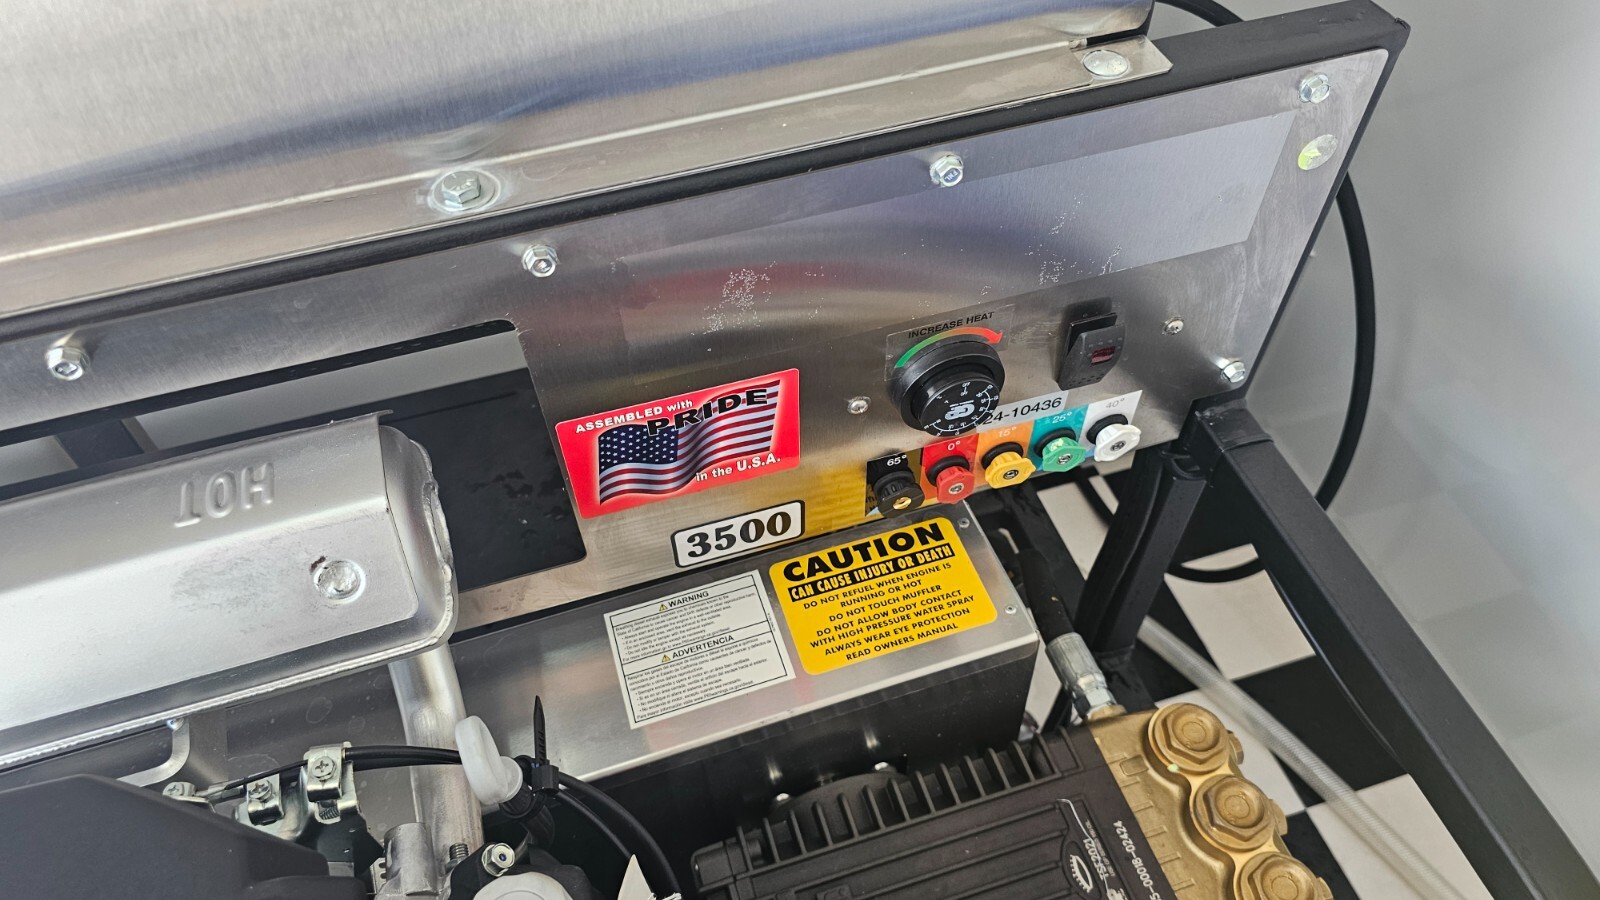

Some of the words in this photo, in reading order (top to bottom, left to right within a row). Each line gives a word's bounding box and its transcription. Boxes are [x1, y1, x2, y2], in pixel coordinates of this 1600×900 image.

[909, 319, 963, 338] INCREASE
[966, 312, 994, 324] HEAT
[575, 405, 663, 433] ASSEMBLED
[666, 400, 693, 412] with
[647, 389, 768, 436] PRIDE
[1052, 412, 1072, 424] 25°
[948, 441, 960, 451] 0°
[998, 426, 1016, 438] 15°
[696, 472, 709, 482] in
[711, 466, 732, 478] the
[736, 452, 781, 471] U.S.A.
[886, 454, 907, 466] 65°
[174, 462, 274, 528] HOT
[687, 511, 791, 557] 3500
[783, 523, 945, 581] CAUTION
[791, 586, 814, 601] CAN
[817, 573, 852, 591] CAUSE
[855, 562, 895, 582] INJURY
[900, 556, 913, 569] OR
[917, 545, 952, 564] DEATH
[804, 601, 817, 609] DO
[820, 595, 840, 604] NOT
[843, 585, 874, 598] REFUEL
[876, 576, 904, 589] WHEN
[907, 566, 941, 580] ENGINE
[668, 590, 709, 607] WARNING
[829, 613, 843, 622] DO
[846, 607, 866, 617] NOT
[868, 597, 900, 610] TOUCH
[902, 585, 942, 600] MUFFLER
[840, 590, 885, 608] RUNNING
[888, 586, 901, 594] OR
[903, 580, 922, 589] HOT
[810, 635, 835, 648] WITH
[840, 627, 864, 639] HIGH
[867, 613, 911, 631] PRESSURE
[914, 604, 945, 617] WATER
[947, 595, 975, 608] SPRAY
[817, 628, 831, 637] DO
[834, 621, 854, 632] NOT
[857, 611, 889, 625] ALLOW
[892, 602, 917, 615] BODY
[920, 590, 962, 606] CONTACT
[825, 640, 861, 655] ALWAYS
[864, 631, 891, 644] WEAR
[894, 625, 909, 634] EYE
[912, 608, 970, 629] PROTECTION
[671, 634, 734, 658] ADVERTENCIA
[846, 647, 871, 660] READ
[874, 635, 915, 651] OWNERS
[917, 623, 958, 639] MANUAL
[1113, 820, 1161, 900] 5-00018-02424
